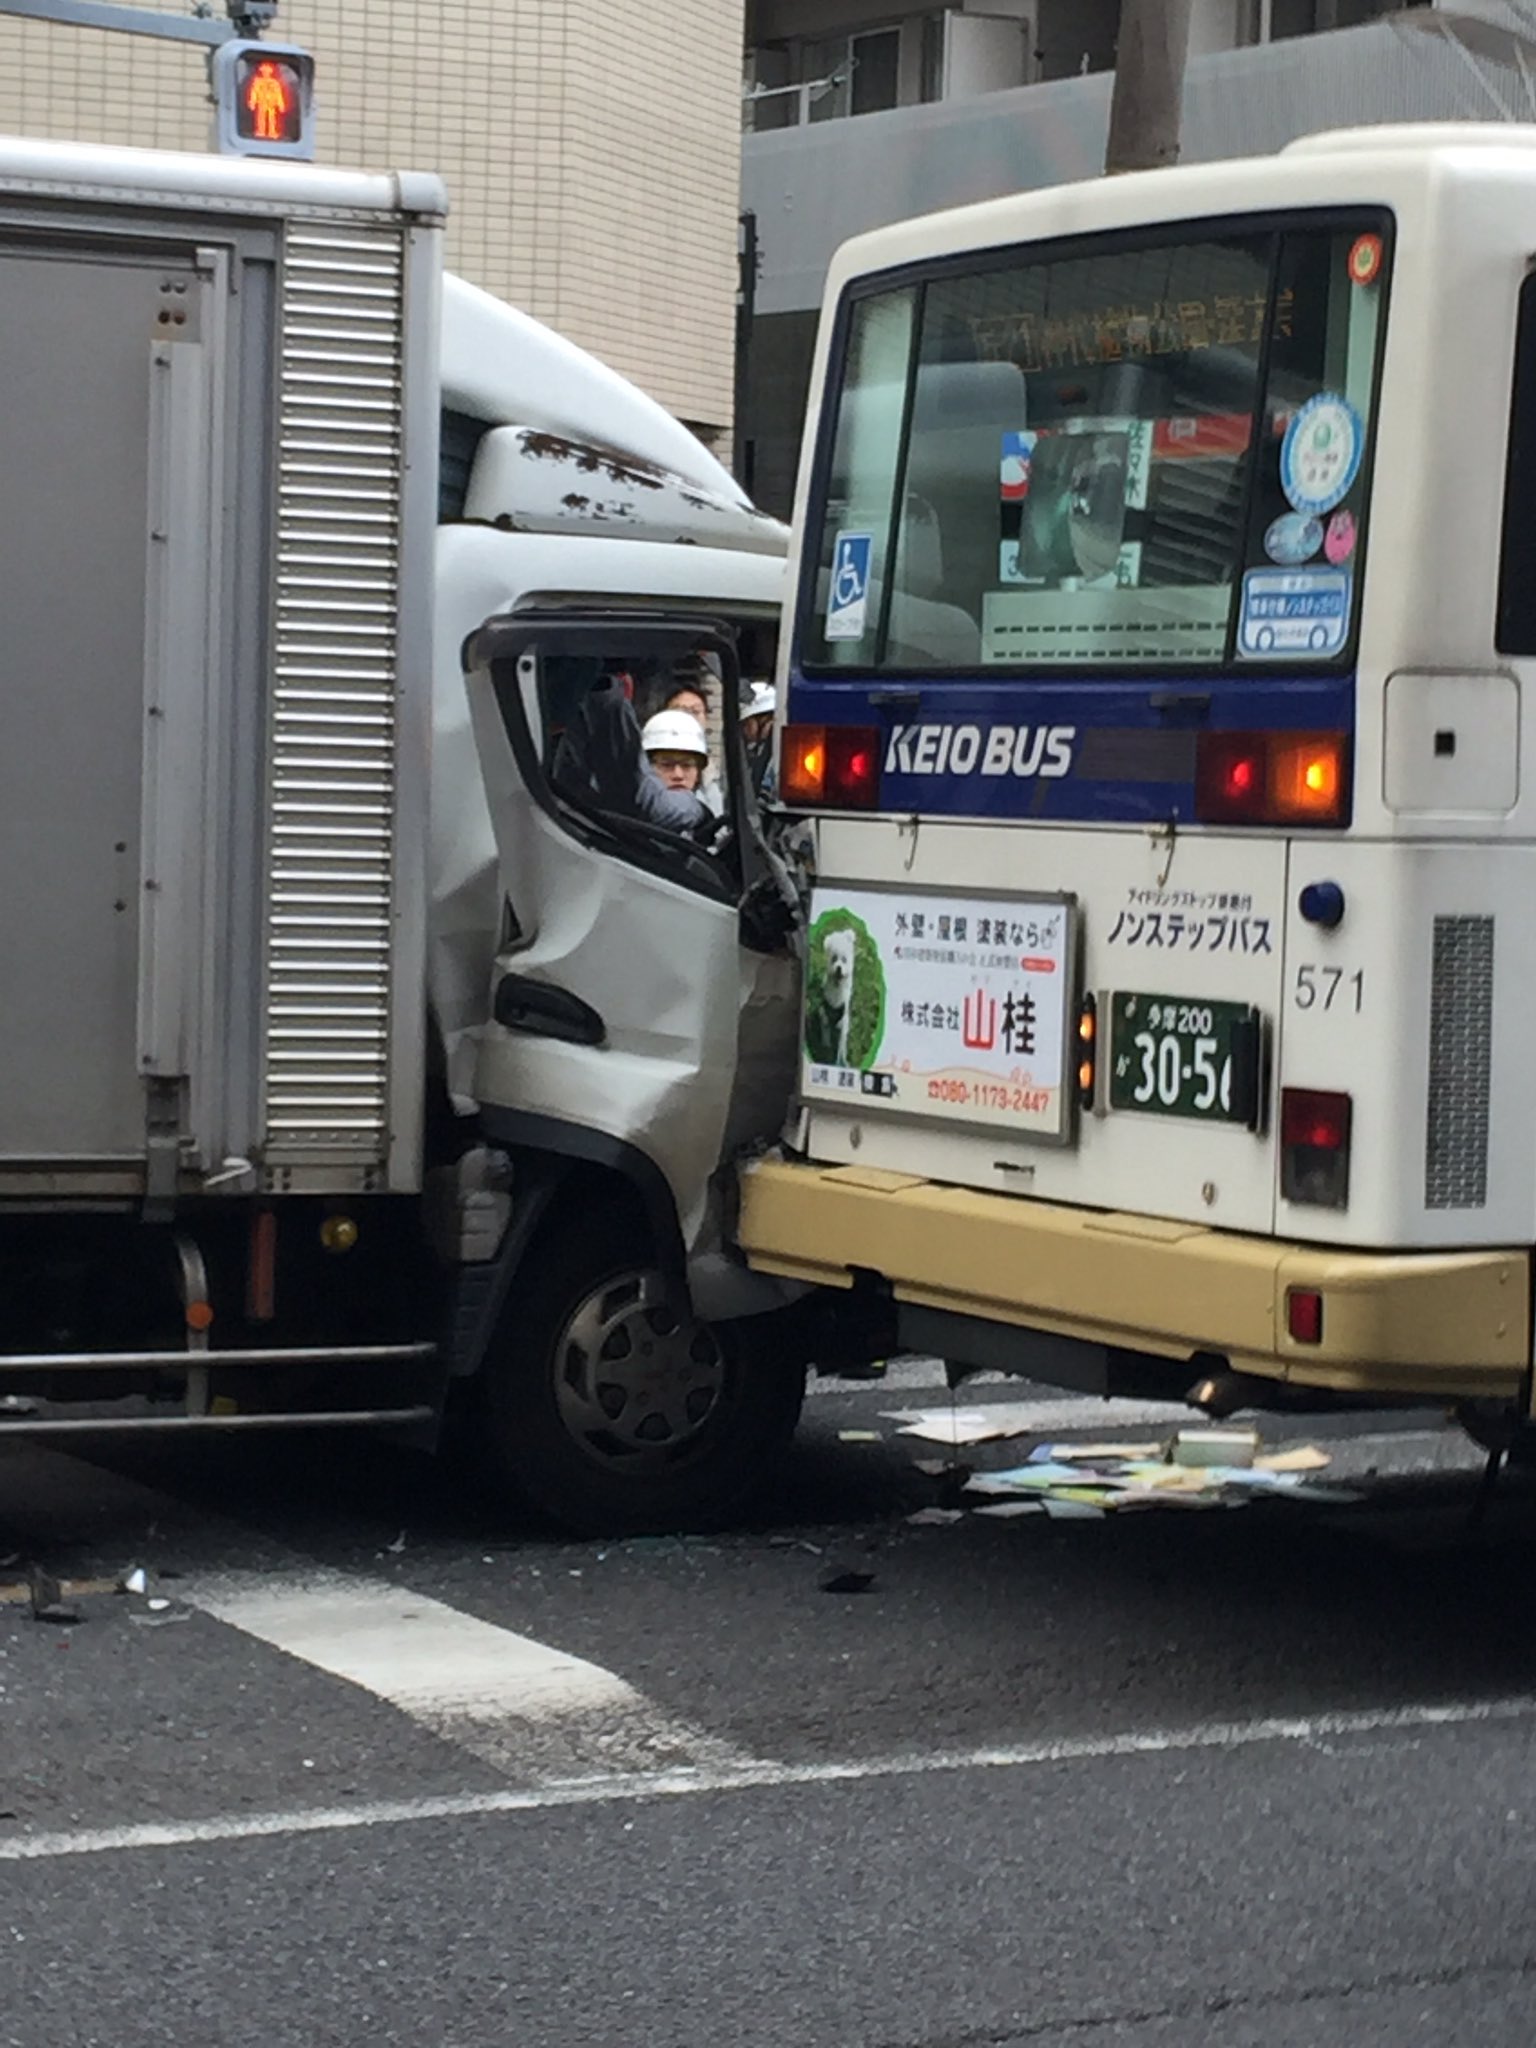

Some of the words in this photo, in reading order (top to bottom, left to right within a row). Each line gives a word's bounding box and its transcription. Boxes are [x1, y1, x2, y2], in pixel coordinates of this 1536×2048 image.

[884, 724, 980, 775] KEIO
[980, 725, 1076, 777] BUS
[1107, 910, 1272, 955] ノンステップバス
[1295, 964, 1363, 1014] 571
[900, 1000, 960, 1032] 株式会社
[962, 987, 1037, 1056] 山桂
